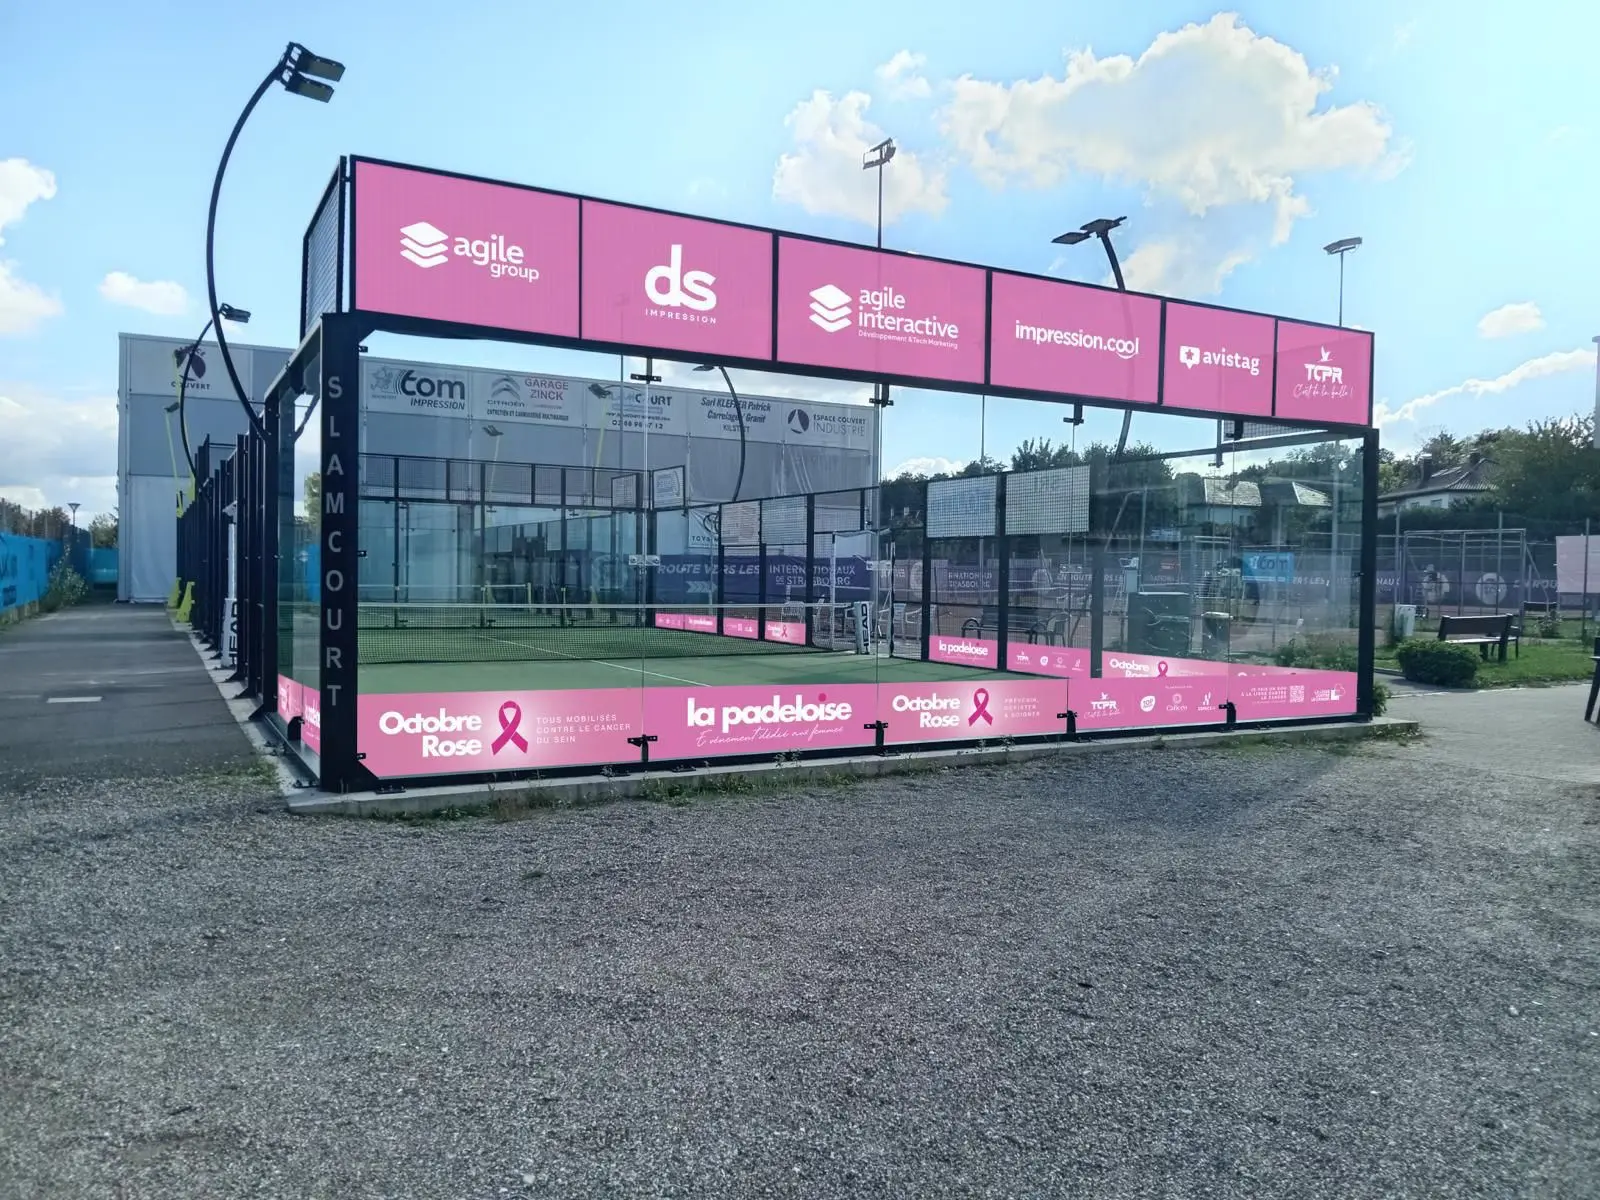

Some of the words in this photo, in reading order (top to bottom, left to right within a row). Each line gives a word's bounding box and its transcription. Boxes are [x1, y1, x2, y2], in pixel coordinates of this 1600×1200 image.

[453, 233, 524, 266] agile
[490, 262, 540, 283] group
[644, 243, 718, 312] ds
[859, 286, 906, 310] agile
[645, 308, 717, 324] IMPRESSION
[858, 305, 959, 339] interactive
[928, 338, 958, 350] Marketing
[1015, 319, 1140, 359] impression.cool
[1203, 347, 1260, 376] avistag
[524, 378, 569, 391] GARAGE
[410, 397, 466, 410] IMPRESSION
[530, 388, 564, 401] ZINCK
[813, 413, 836, 422] ESPACE
[838, 415, 866, 425] COUVERT
[813, 421, 866, 437] INDUSTRIE
[325, 375, 345, 707] SLAMCOURT
[657, 563, 702, 575] ROUTE
[859, 603, 870, 655] HEAD
[938, 640, 947, 652] la
[1109, 659, 1150, 672] Octobre
[892, 692, 961, 712] Octobre
[379, 707, 483, 735] Octobre
[536, 716, 562, 725] TOUS
[687, 697, 715, 727] la
[722, 692, 853, 733] padeloise
[919, 711, 961, 729] Rose
[536, 725, 575, 735] CONTRE
[579, 724, 590, 733] LE
[594, 722, 631, 732] CANCER
[422, 735, 483, 758] Rose
[536, 736, 550, 745] DU
[553, 735, 576, 744] SEIN
